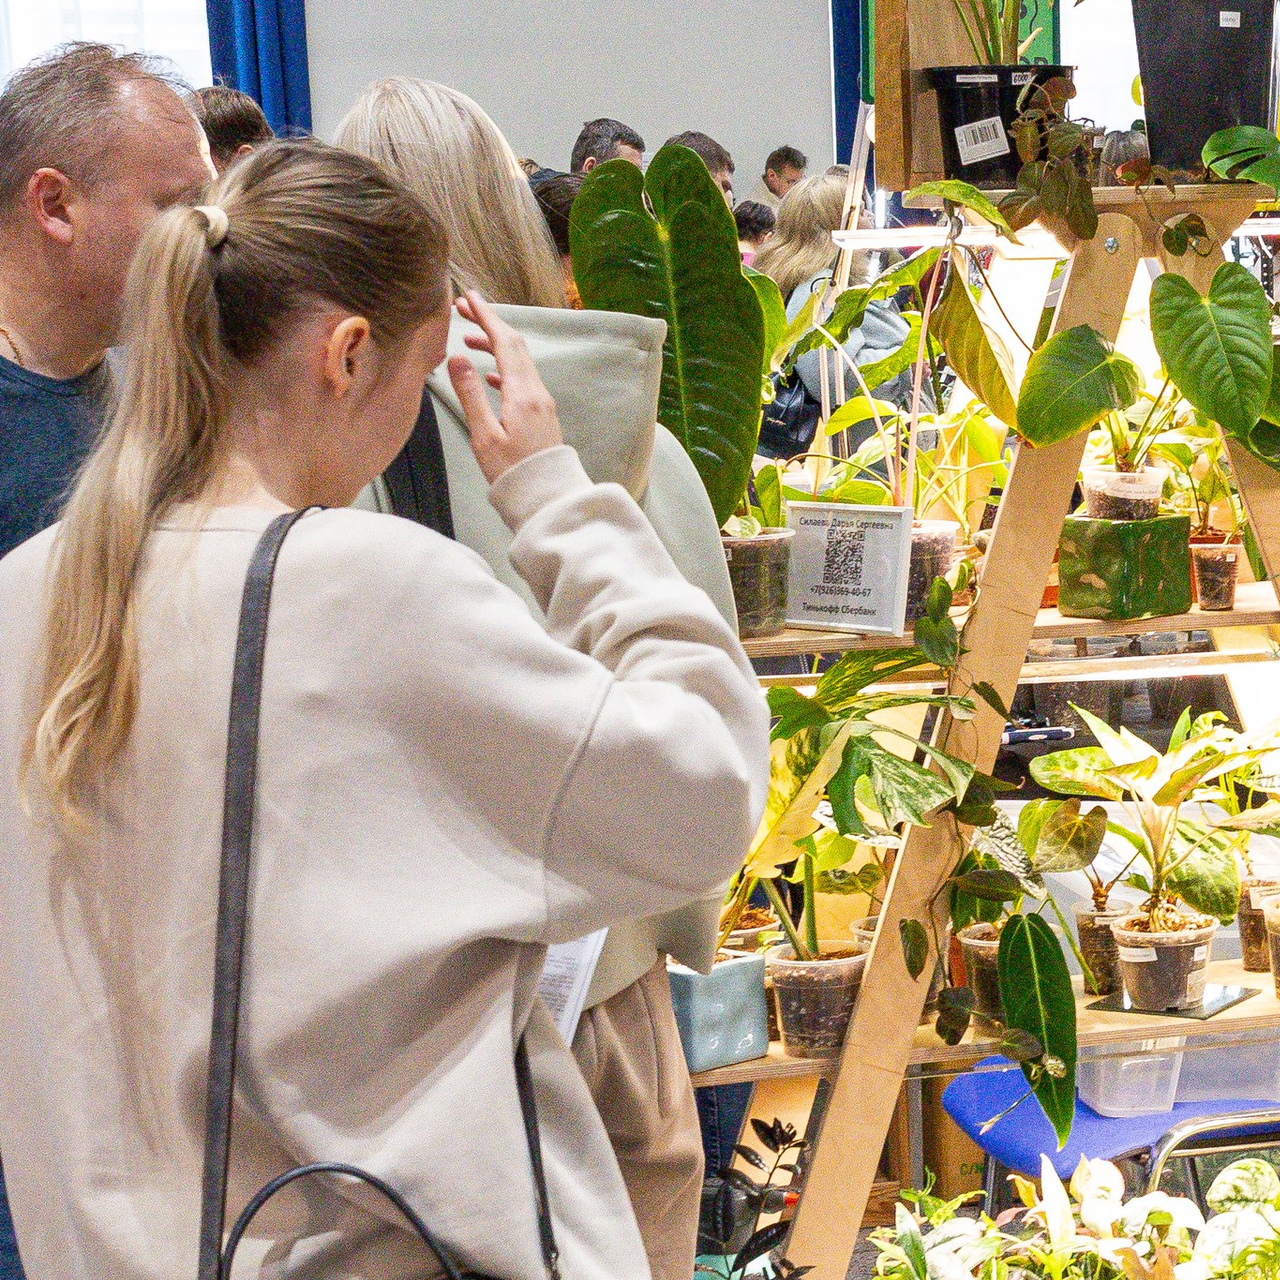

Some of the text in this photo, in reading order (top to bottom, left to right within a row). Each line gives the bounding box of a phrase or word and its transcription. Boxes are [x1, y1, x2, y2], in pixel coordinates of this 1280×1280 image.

[1014, 74, 1029, 83] 6000
[856, 519, 893, 530] Сергеевна
[803, 602, 877, 617] Тинькофф Сбербанк
